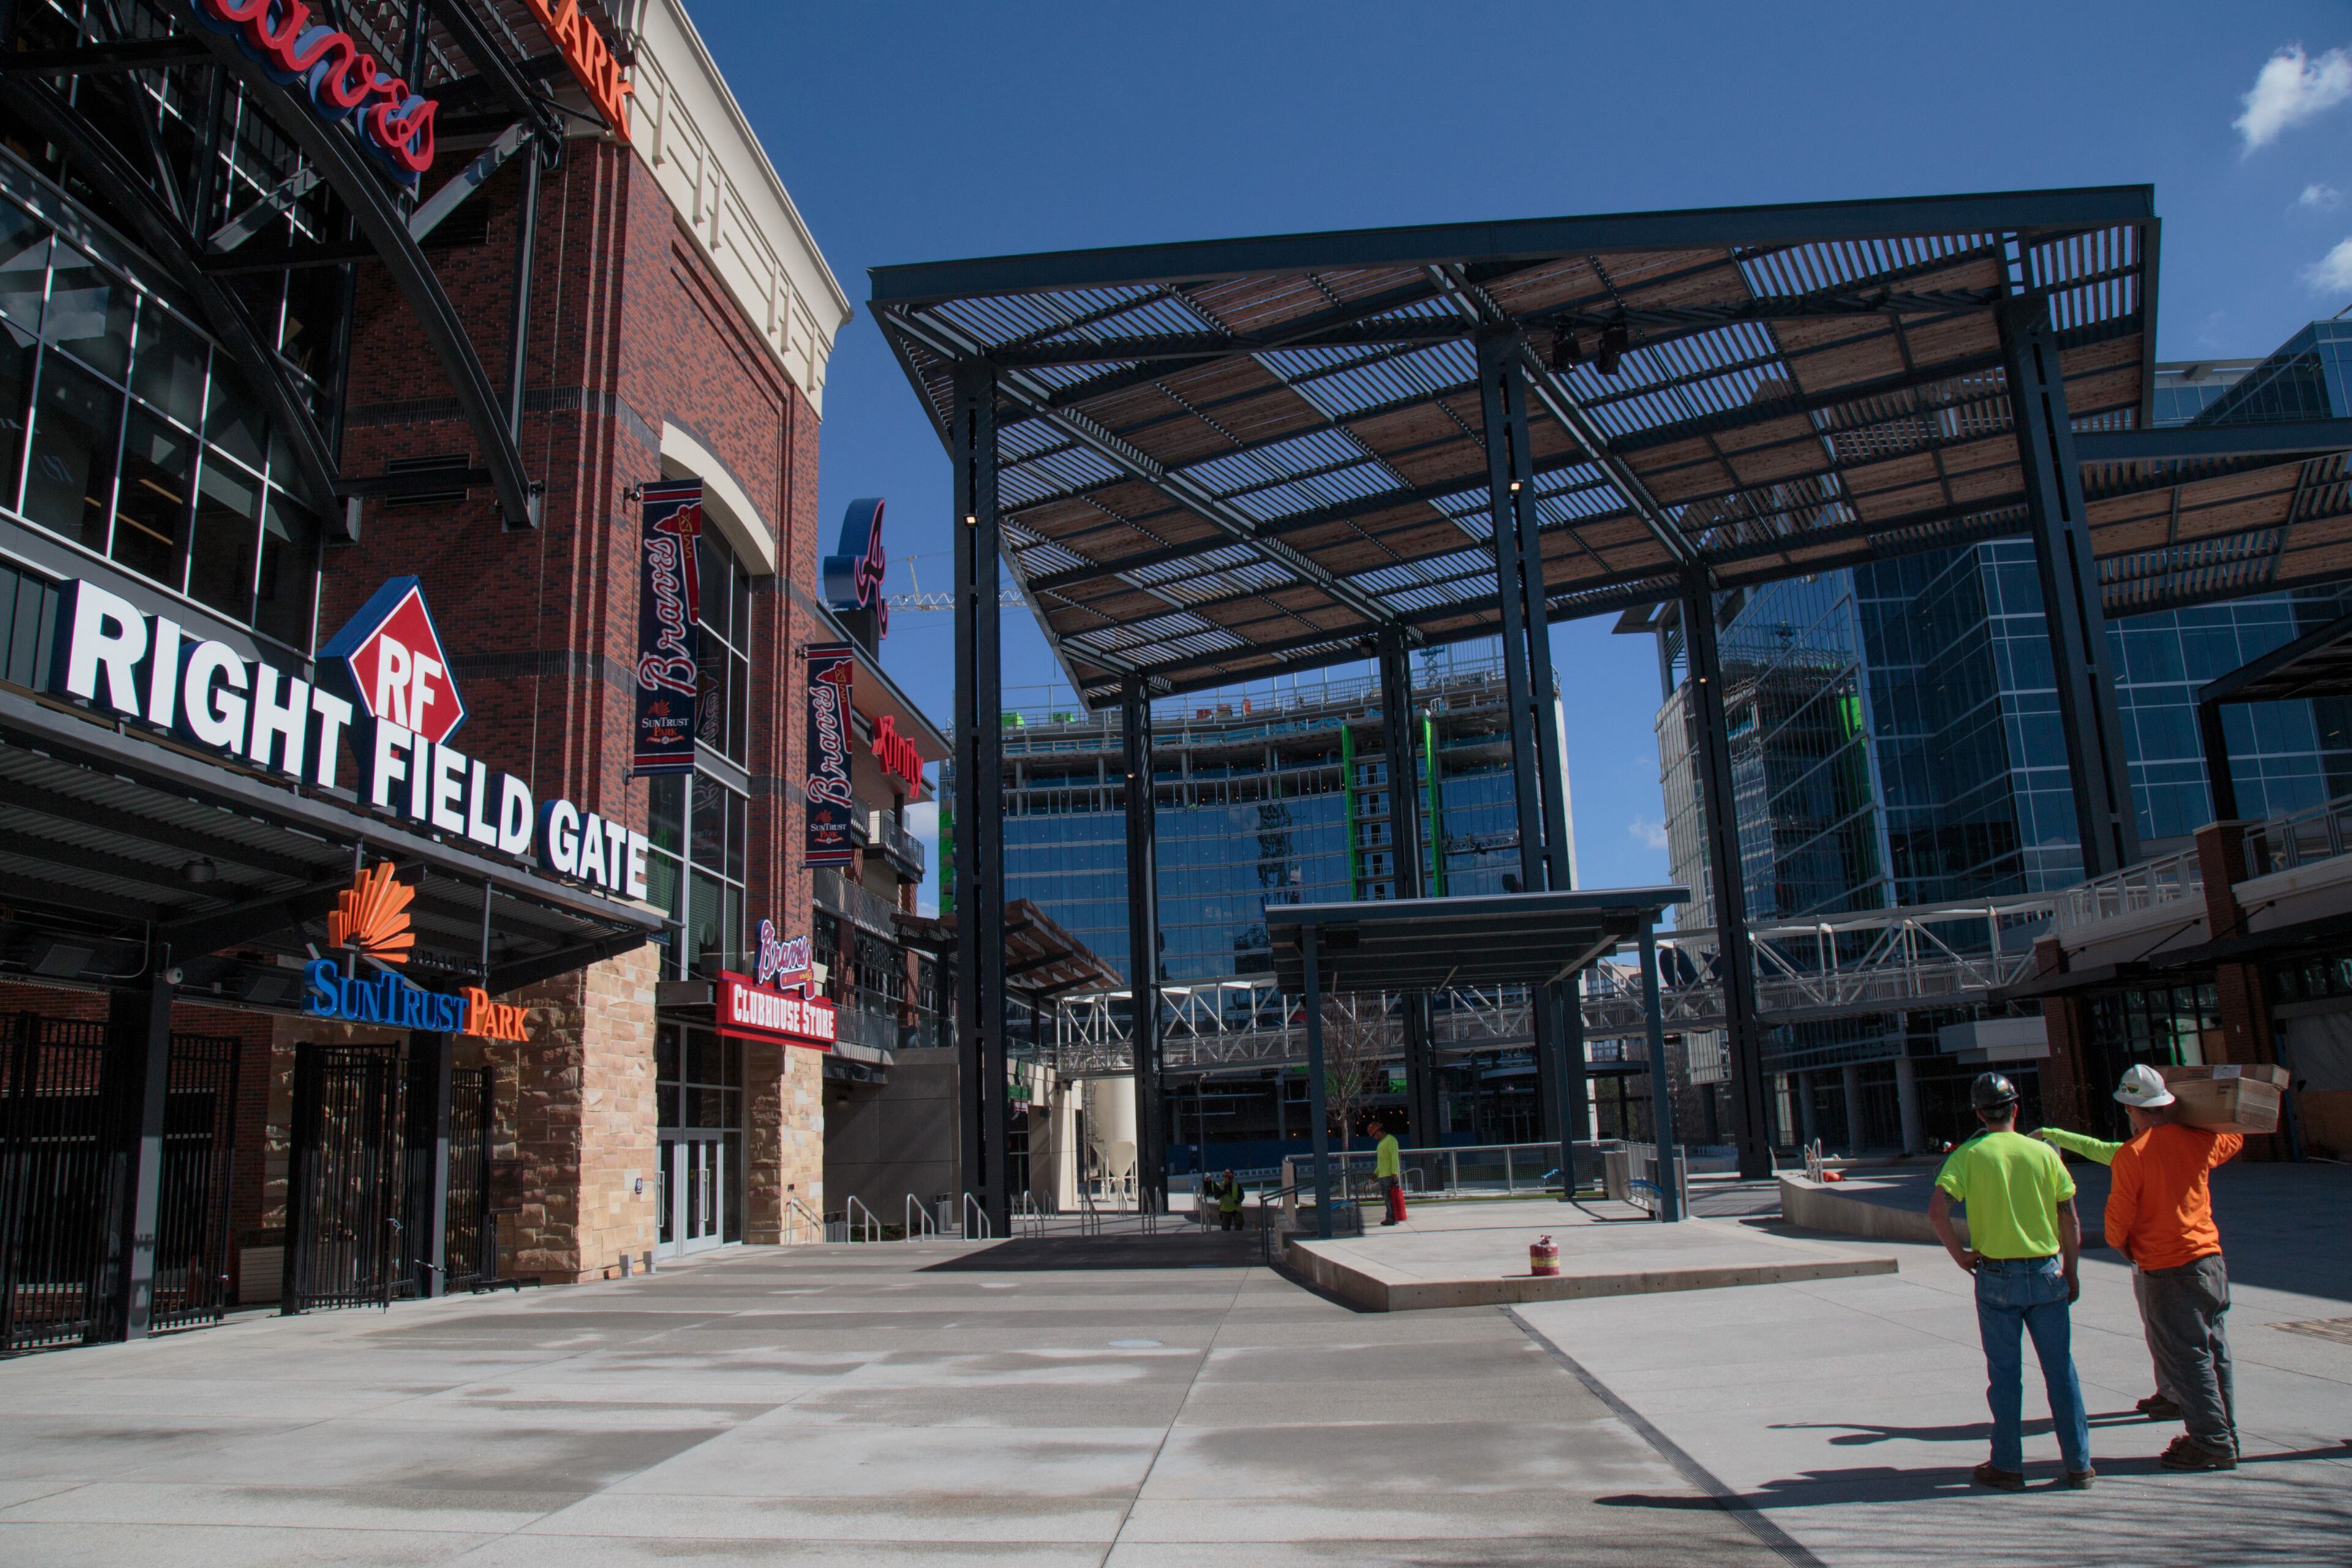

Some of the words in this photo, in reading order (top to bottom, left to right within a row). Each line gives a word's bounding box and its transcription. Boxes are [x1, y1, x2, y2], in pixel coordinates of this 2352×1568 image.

[638, 537, 697, 698] Braves
[374, 632, 443, 734] RF
[67, 578, 352, 790] RIGHT
[371, 715, 533, 855] FIELD
[548, 798, 648, 900] GATE
[654, 726, 677, 737] PARK
[807, 686, 853, 809] Braves
[758, 919, 807, 984] Braves
[466, 987, 530, 1042] PARK
[733, 984, 800, 1033] CLUBHOUSE
[802, 1000, 834, 1040] STORE
